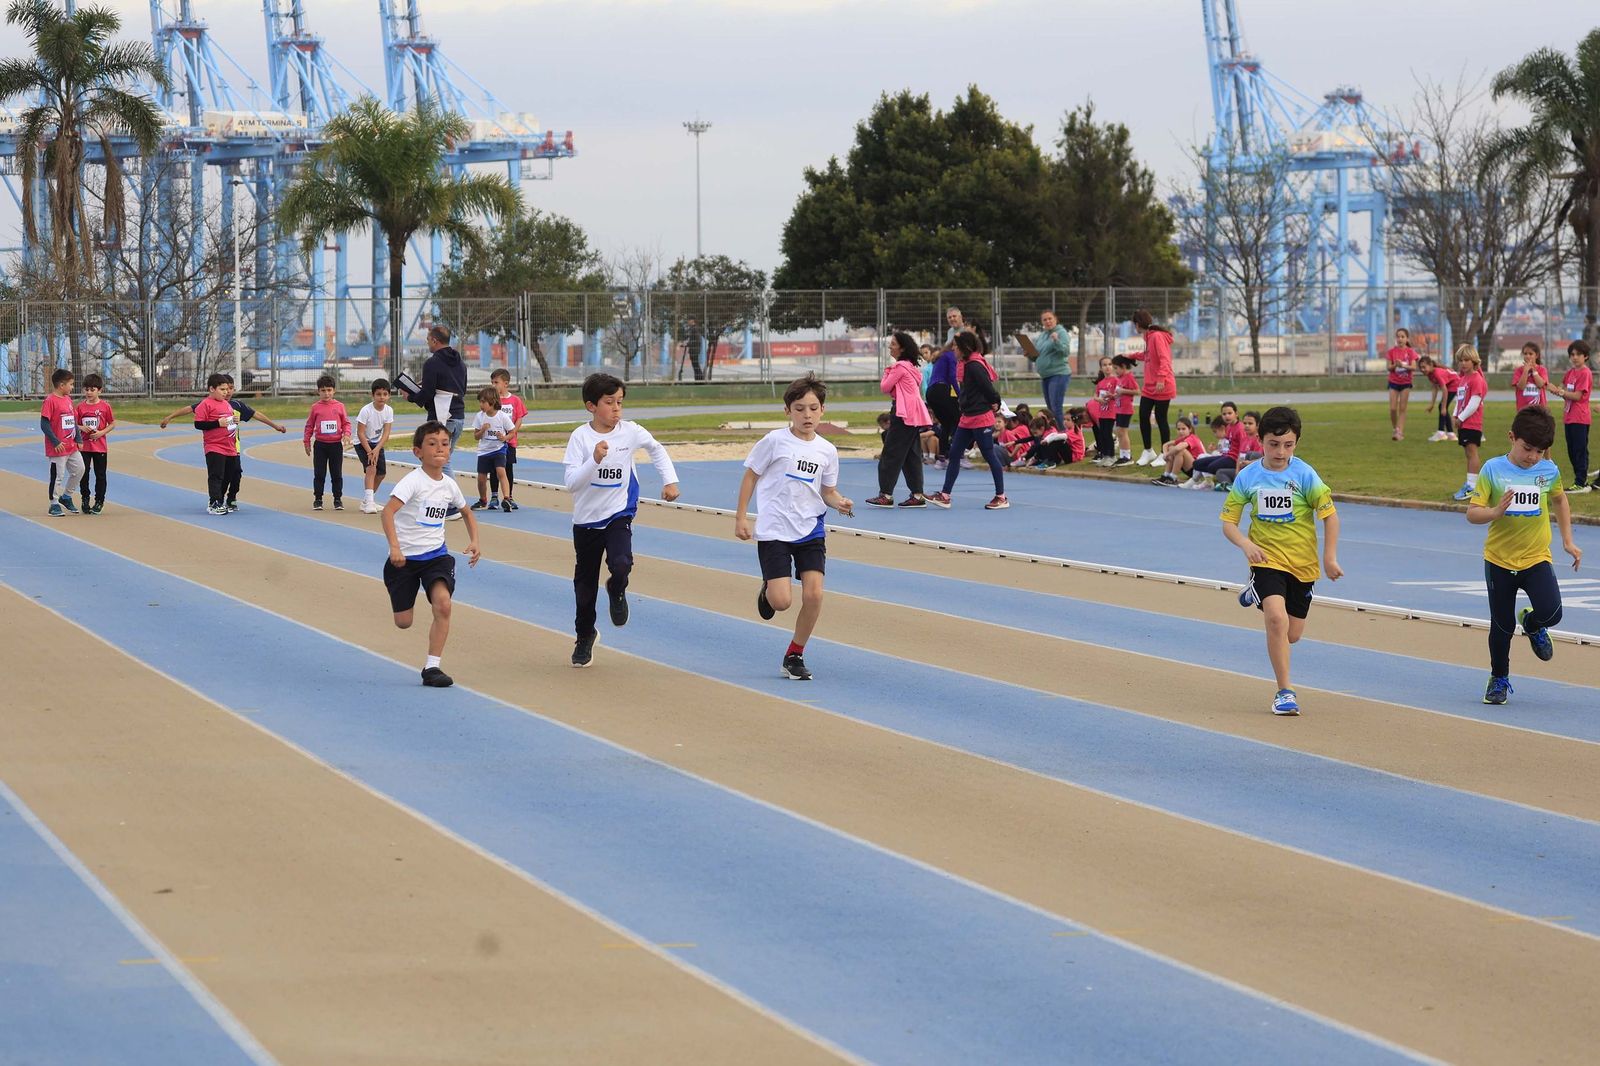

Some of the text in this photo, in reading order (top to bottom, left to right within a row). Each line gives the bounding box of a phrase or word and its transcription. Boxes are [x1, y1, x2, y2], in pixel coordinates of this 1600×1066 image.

[597, 467, 622, 480] 1058
[797, 459, 819, 475] 1057
[1263, 495, 1292, 509] 1025
[1513, 492, 1539, 505] 1018
[425, 506, 446, 519] 1059
